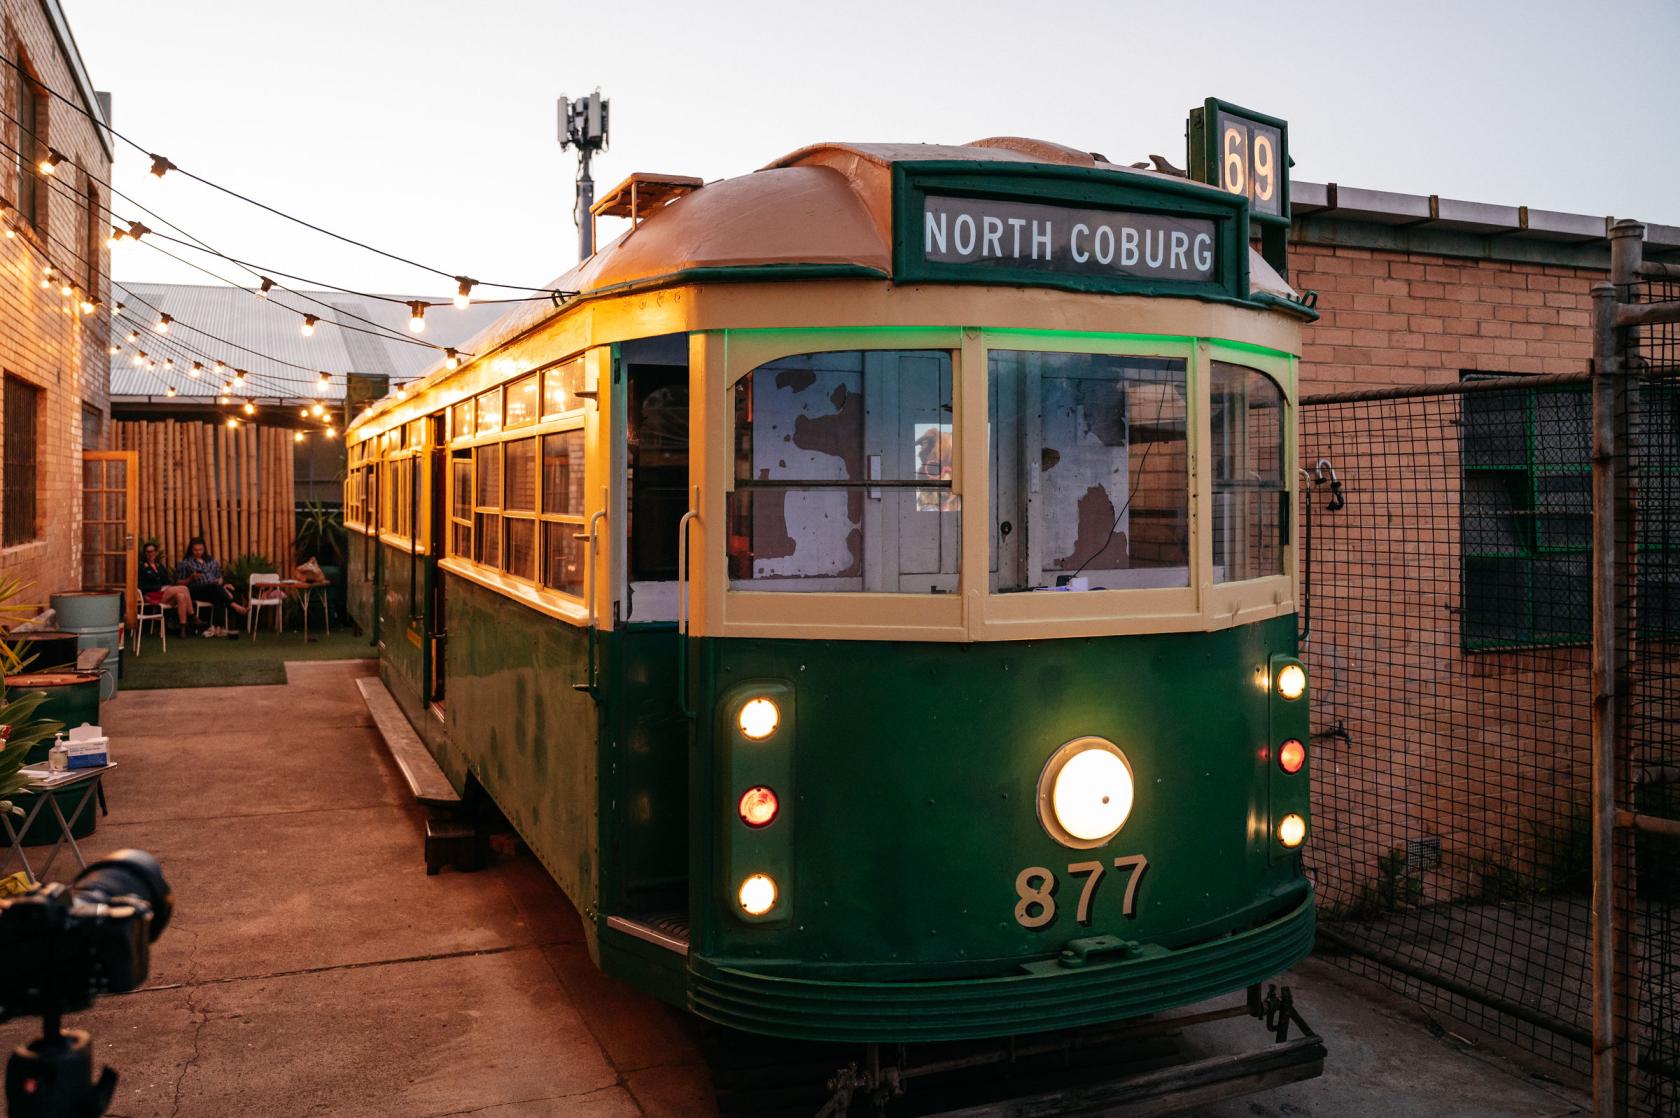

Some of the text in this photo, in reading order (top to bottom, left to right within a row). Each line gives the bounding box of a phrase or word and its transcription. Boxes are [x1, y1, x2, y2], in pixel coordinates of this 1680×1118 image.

[1223, 127, 1274, 202] 69
[925, 211, 1213, 272] NORTH COBURG
[1014, 854, 1148, 928] 877
